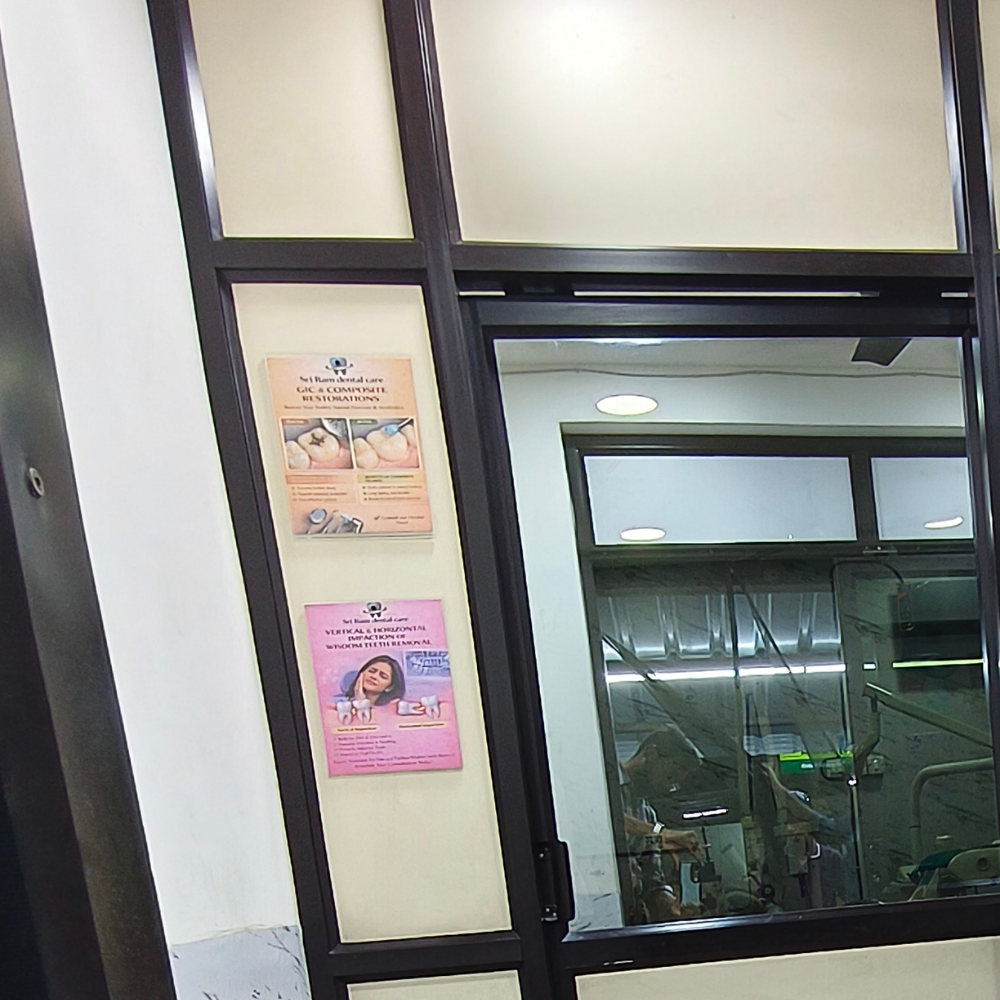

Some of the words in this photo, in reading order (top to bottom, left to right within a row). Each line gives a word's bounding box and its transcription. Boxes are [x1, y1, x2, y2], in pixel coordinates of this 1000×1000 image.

[326, 386, 386, 394] COMPOSITE
[373, 625, 426, 633] HORIZONTAL
[391, 639, 431, 647] REMOVAL
